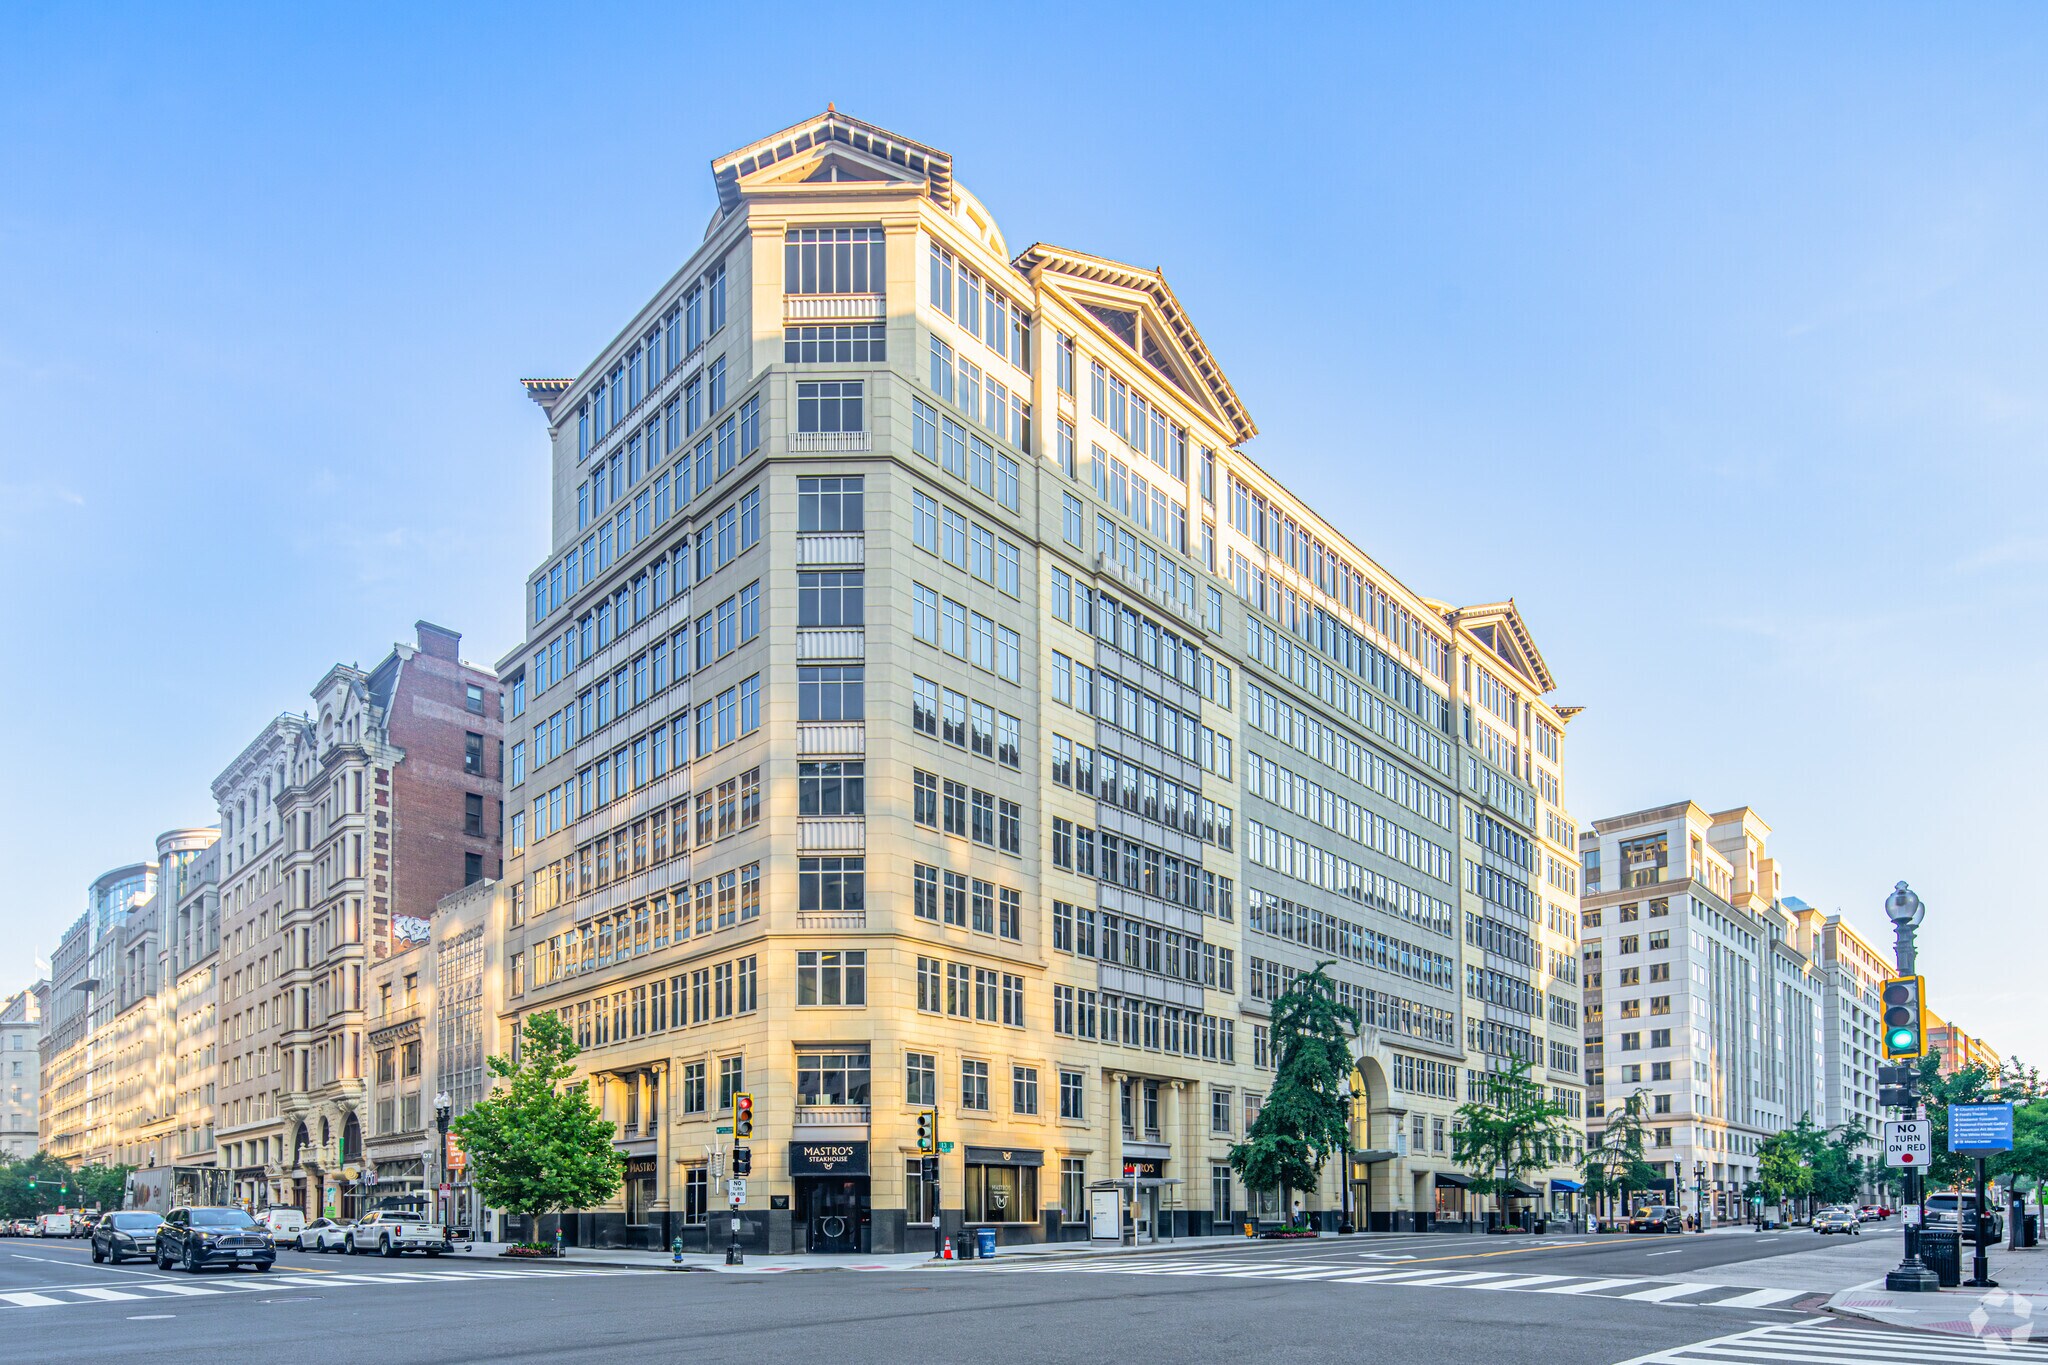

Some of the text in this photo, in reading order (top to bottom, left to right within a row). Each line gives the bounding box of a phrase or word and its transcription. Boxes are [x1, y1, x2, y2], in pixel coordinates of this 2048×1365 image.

[1897, 1124, 1916, 1133] NO
[1895, 1134, 1920, 1142] TURN
[803, 1146, 854, 1156] MASTRO'S
[1889, 1143, 1926, 1152] ON RED
